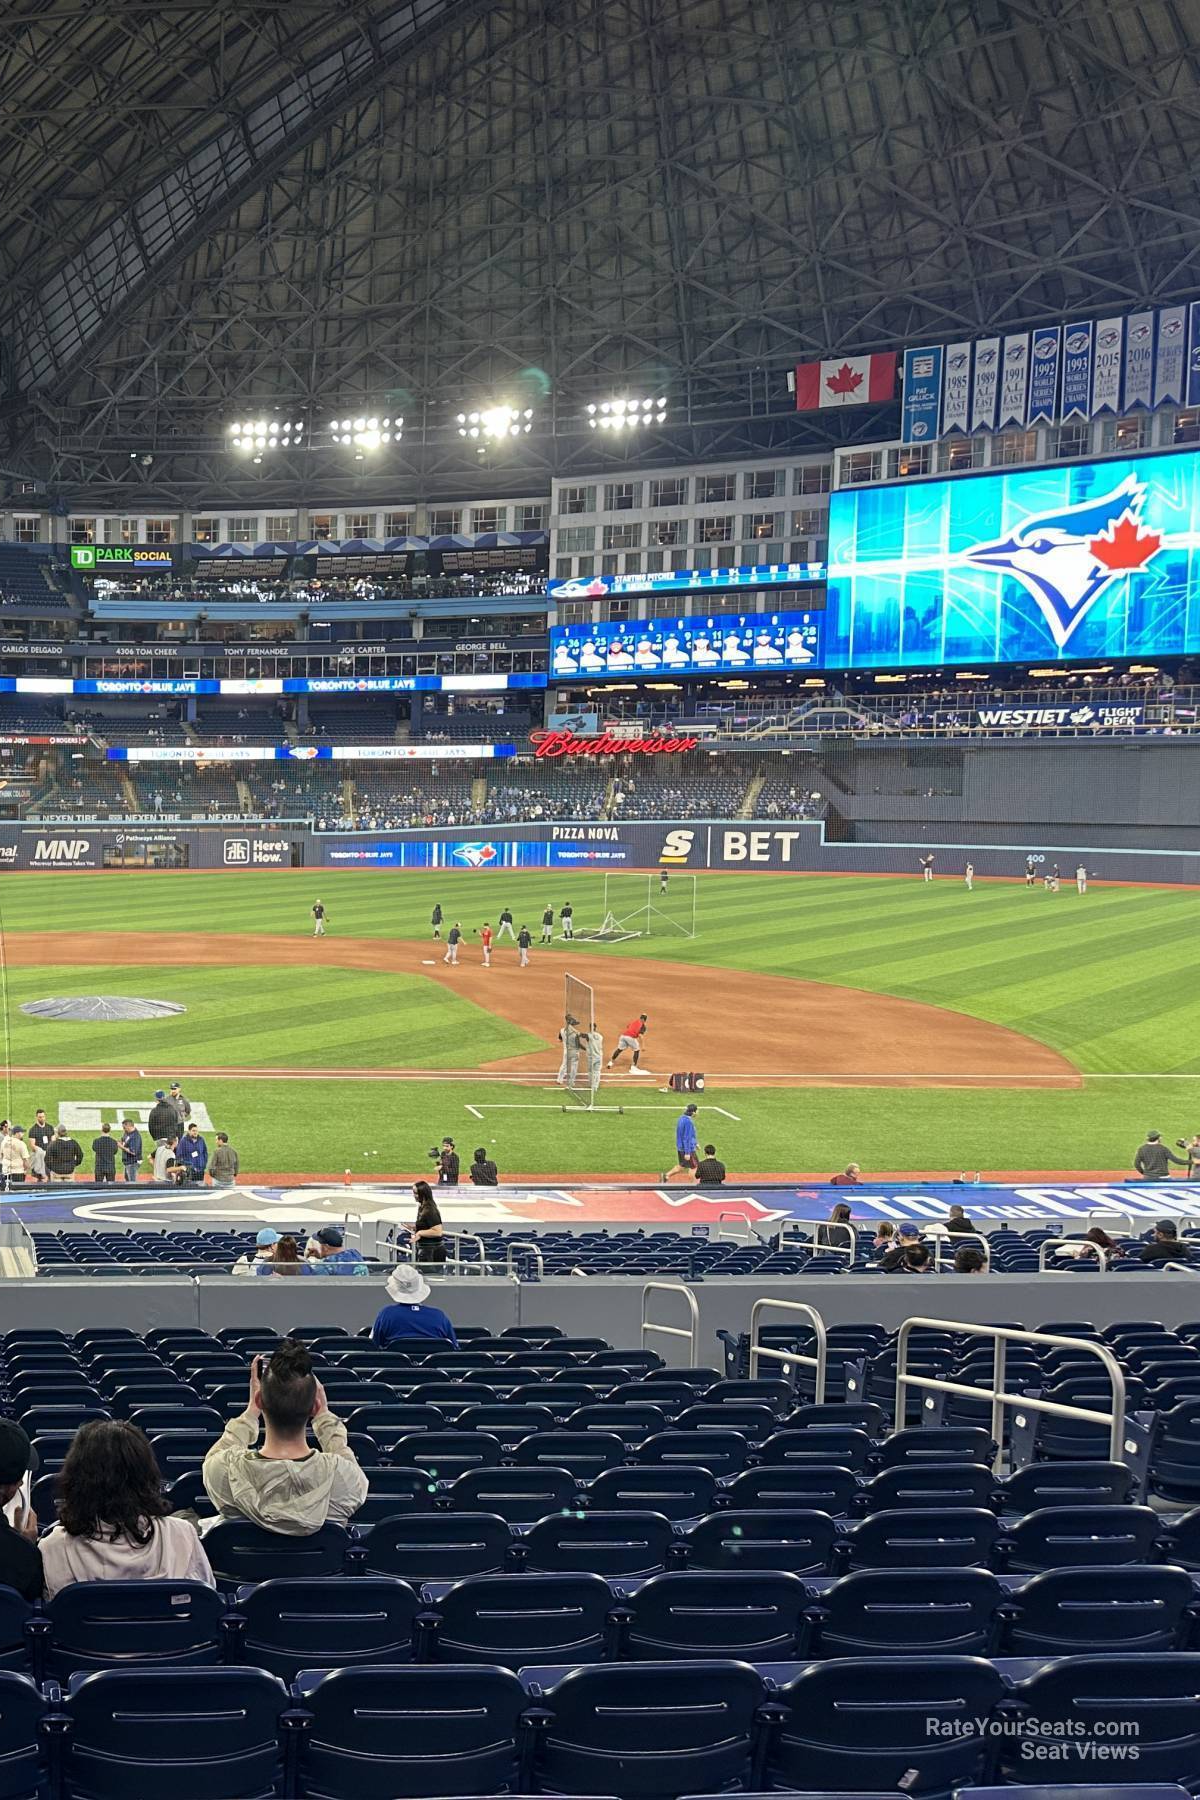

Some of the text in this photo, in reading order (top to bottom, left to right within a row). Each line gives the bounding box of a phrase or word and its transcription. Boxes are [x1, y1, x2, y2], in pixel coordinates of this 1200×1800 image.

[1097, 352, 1119, 368] 2015
[1128, 348, 1150, 362] 2016
[1034, 362, 1055, 377] 1992
[1067, 357, 1087, 372] 1993
[976, 372, 995, 385] 1989
[1005, 368, 1024, 381] 1991
[1066, 372, 1087, 381] WORLD
[948, 376, 967, 389] 1985
[1033, 378, 1054, 386] WORLD
[1033, 389, 1053, 397] SERIES
[1066, 384, 1086, 392] SERIES
[975, 398, 993, 407] EAST
[1004, 394, 1023, 404] EAST
[1032, 399, 1053, 408] CHAMPS
[1065, 394, 1087, 403] CHAMPS
[946, 401, 966, 411] EAST
[73, 548, 172, 564] TD PARK SOCIAL
[615, 574, 647, 583] STARTING
[648, 571, 675, 581] PITCHER
[564, 628, 569, 637] 1
[620, 624, 625, 633] 3
[739, 617, 745, 626] 7
[803, 627, 816, 636] 28
[712, 631, 721, 639] 11
[778, 628, 784, 637] 7
[568, 639, 580, 647] 36
[595, 638, 607, 646] 25
[622, 636, 634, 644] 27
[655, 634, 662, 642] 2
[30, 646, 63, 654] DELGADO
[455, 642, 507, 651] GEORGE BELL
[154, 648, 178, 656] CHEEK
[96, 682, 196, 692] TORONTO BLUE JAYS
[307, 679, 415, 690] TORONTO BLUE JAYS
[1098, 707, 1143, 717] FLIGHT
[1104, 716, 1136, 726] DECK
[13, 736, 30, 745] Jays
[530, 732, 698, 757] Budweiser
[552, 827, 619, 840] PIZZA NOVA
[34, 840, 90, 860] MNP
[253, 840, 289, 851] Here's
[722, 831, 800, 862] BET
[253, 852, 282, 862] How.
[1026, 855, 1045, 863] 400
[842, 1196, 954, 1219] TO
[959, 1205, 1060, 1218] THE
